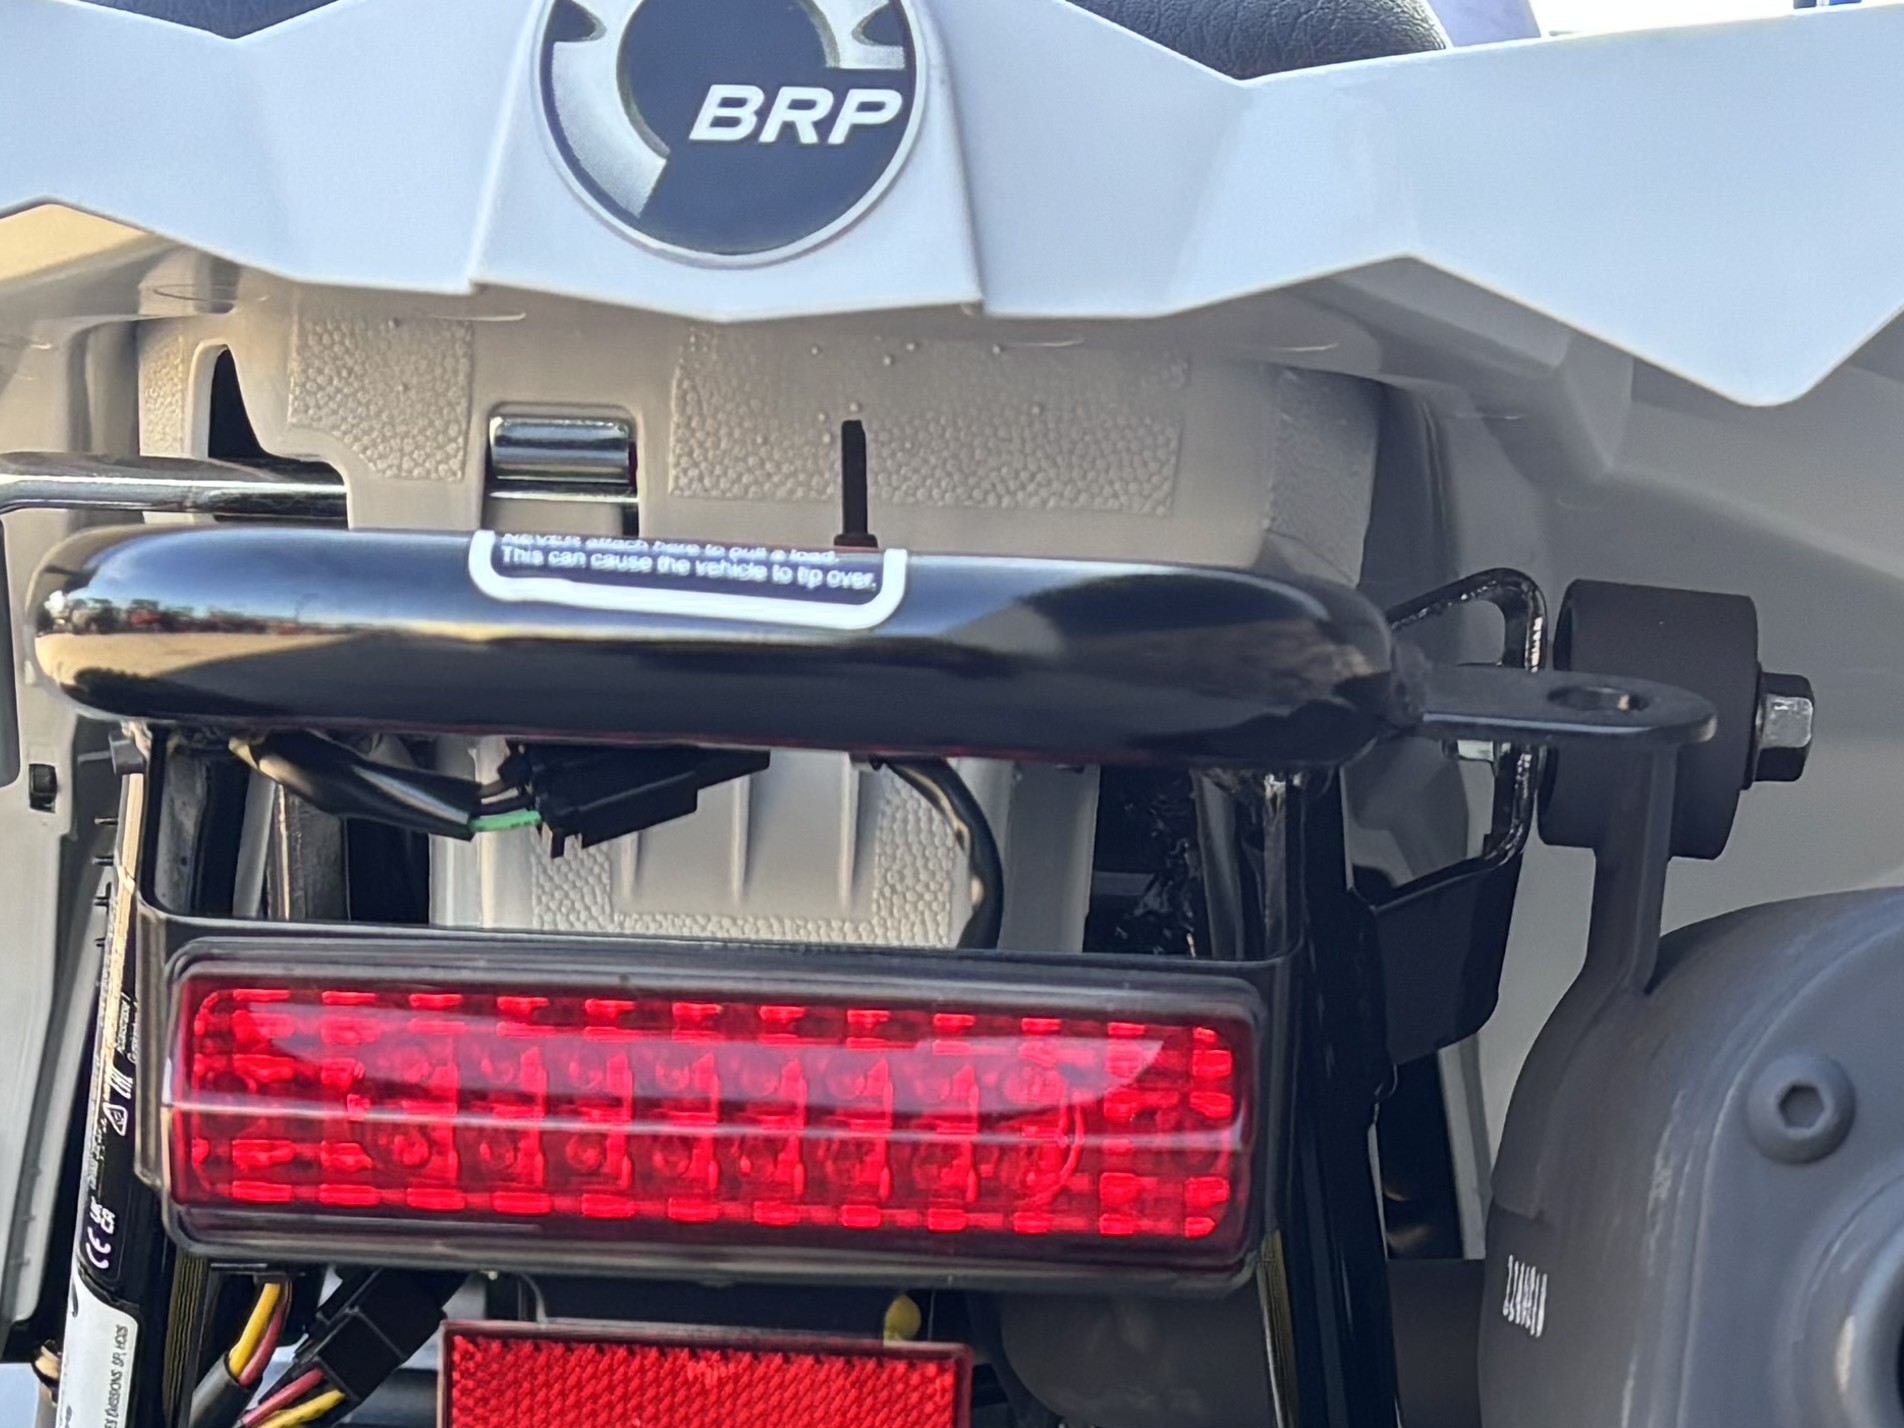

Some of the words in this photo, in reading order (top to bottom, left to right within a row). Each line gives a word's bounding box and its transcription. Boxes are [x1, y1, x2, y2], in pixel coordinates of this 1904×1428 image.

[689, 83, 904, 145] BRP
[501, 546, 544, 566] This
[548, 551, 586, 568] can
[590, 553, 653, 572] cause
[656, 555, 691, 576] the
[695, 559, 768, 582] vehicle
[772, 564, 792, 584] to
[798, 565, 823, 590] tip
[827, 570, 876, 590] over.
